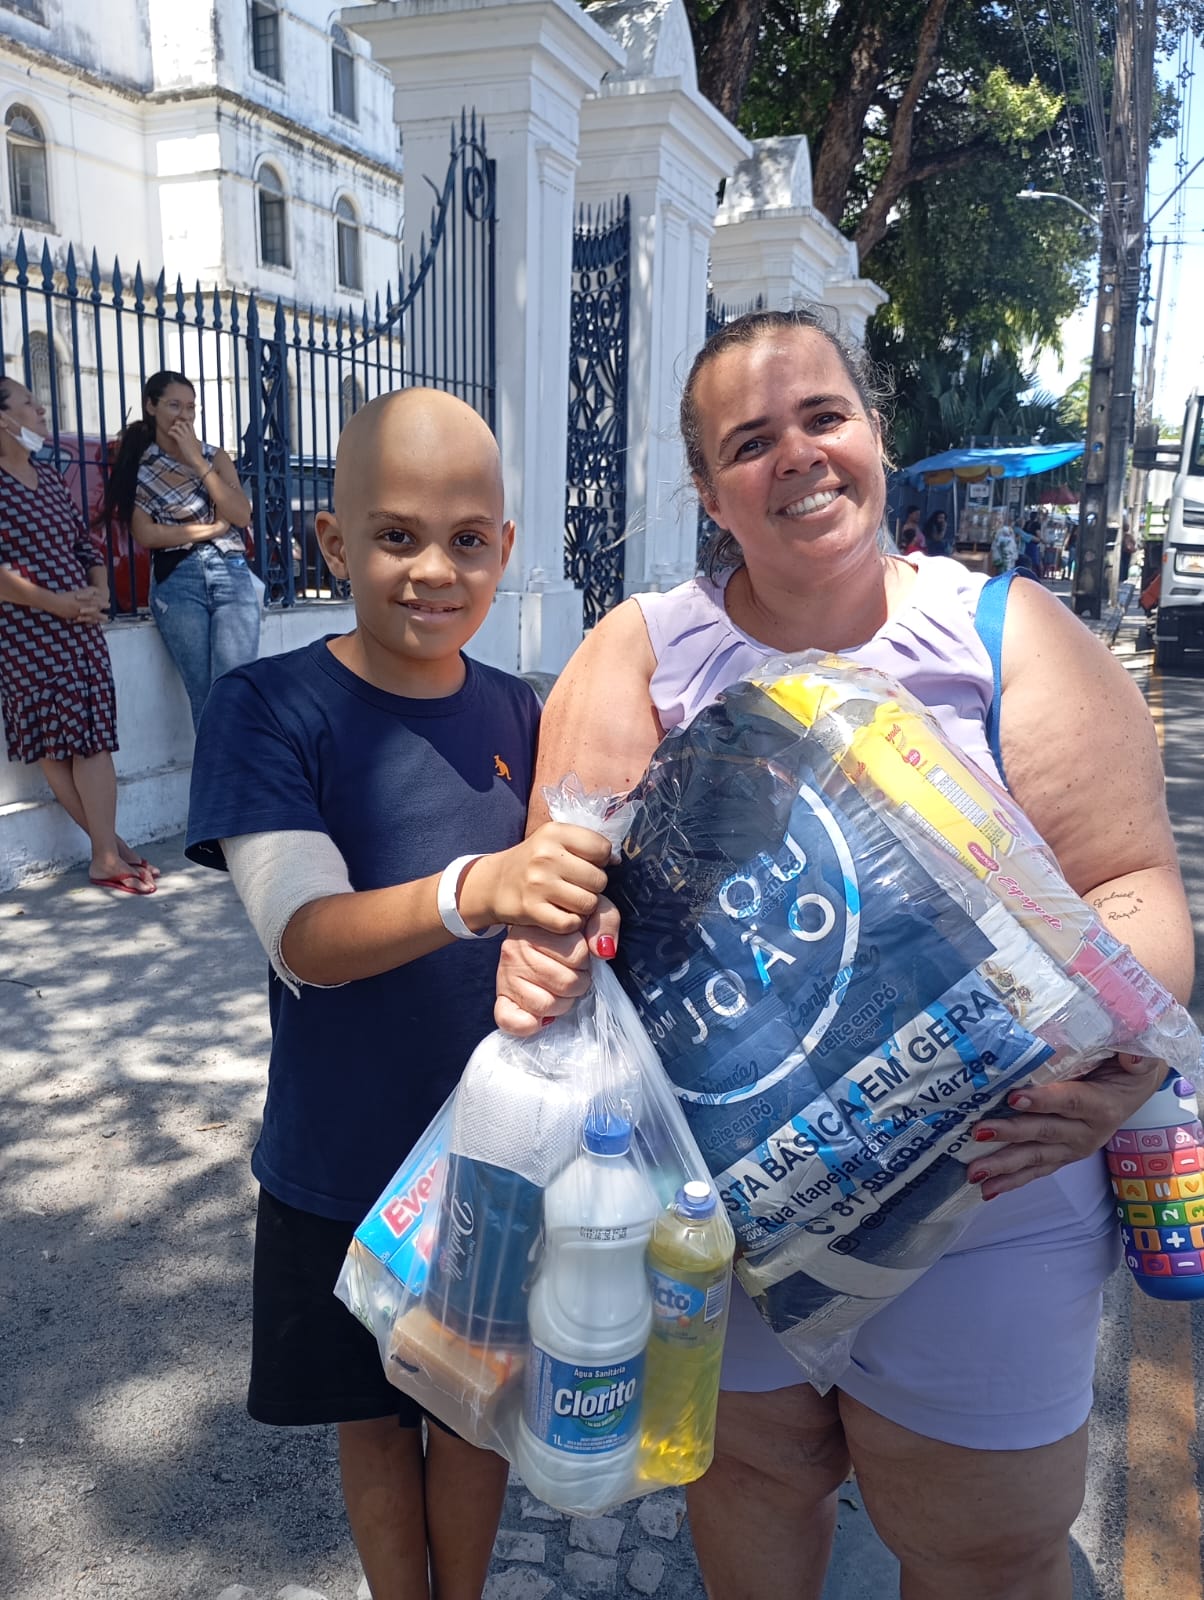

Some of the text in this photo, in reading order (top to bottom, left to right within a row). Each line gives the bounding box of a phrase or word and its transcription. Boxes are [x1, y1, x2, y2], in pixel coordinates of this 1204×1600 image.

[682, 893, 836, 1045] JOÃO
[816, 982, 898, 1057] Leite em Pó
[851, 1019, 881, 1047] Integral
[720, 1174, 769, 1213] STA
[760, 1098, 868, 1183] BÁSICA
[857, 1065, 911, 1102] EM
[908, 978, 1016, 1064] GERAL
[703, 1099, 772, 1151] Leite em Pó
[757, 1203, 798, 1234] Rua
[919, 1048, 999, 1106] Várzea
[832, 1193, 866, 1219] 81
[554, 1377, 636, 1418] Clorito
[552, 1434, 563, 1447] 1L
